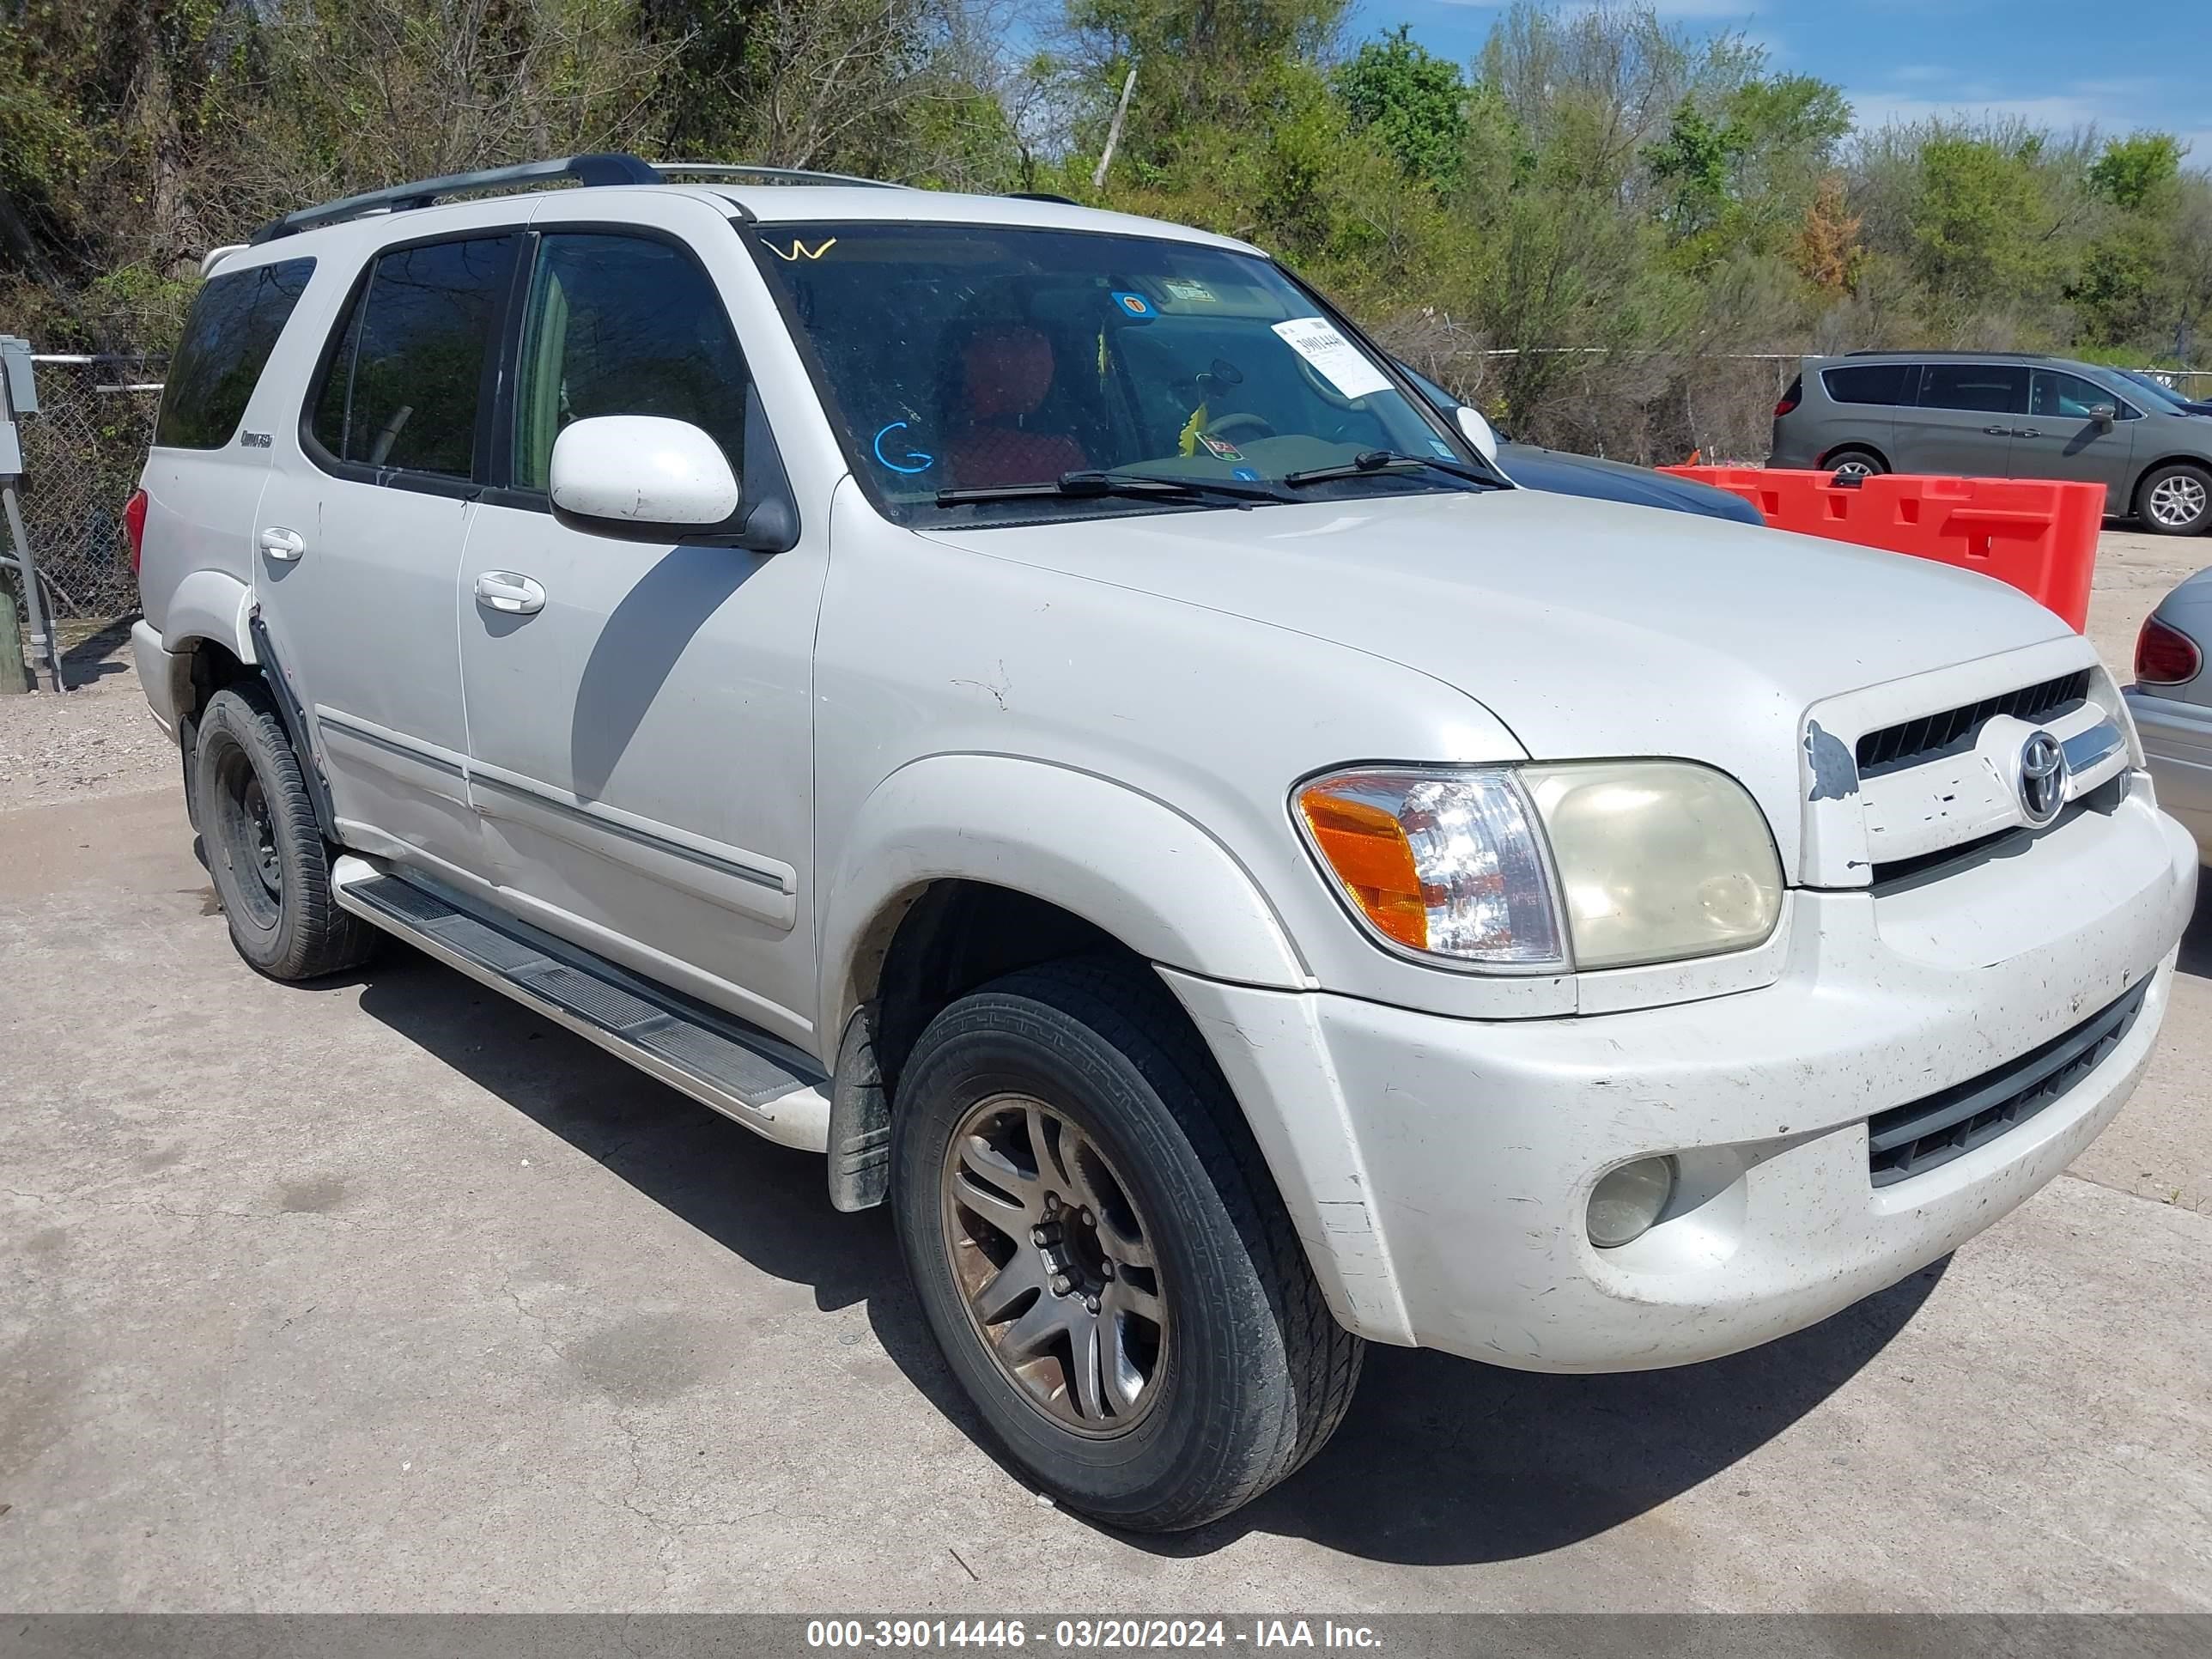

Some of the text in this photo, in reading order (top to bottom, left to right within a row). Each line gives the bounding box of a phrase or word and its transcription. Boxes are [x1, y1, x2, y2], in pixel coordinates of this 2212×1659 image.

[760, 236, 838, 261] W
[1296, 332, 1346, 354] 39014446
[874, 422, 934, 473] G
